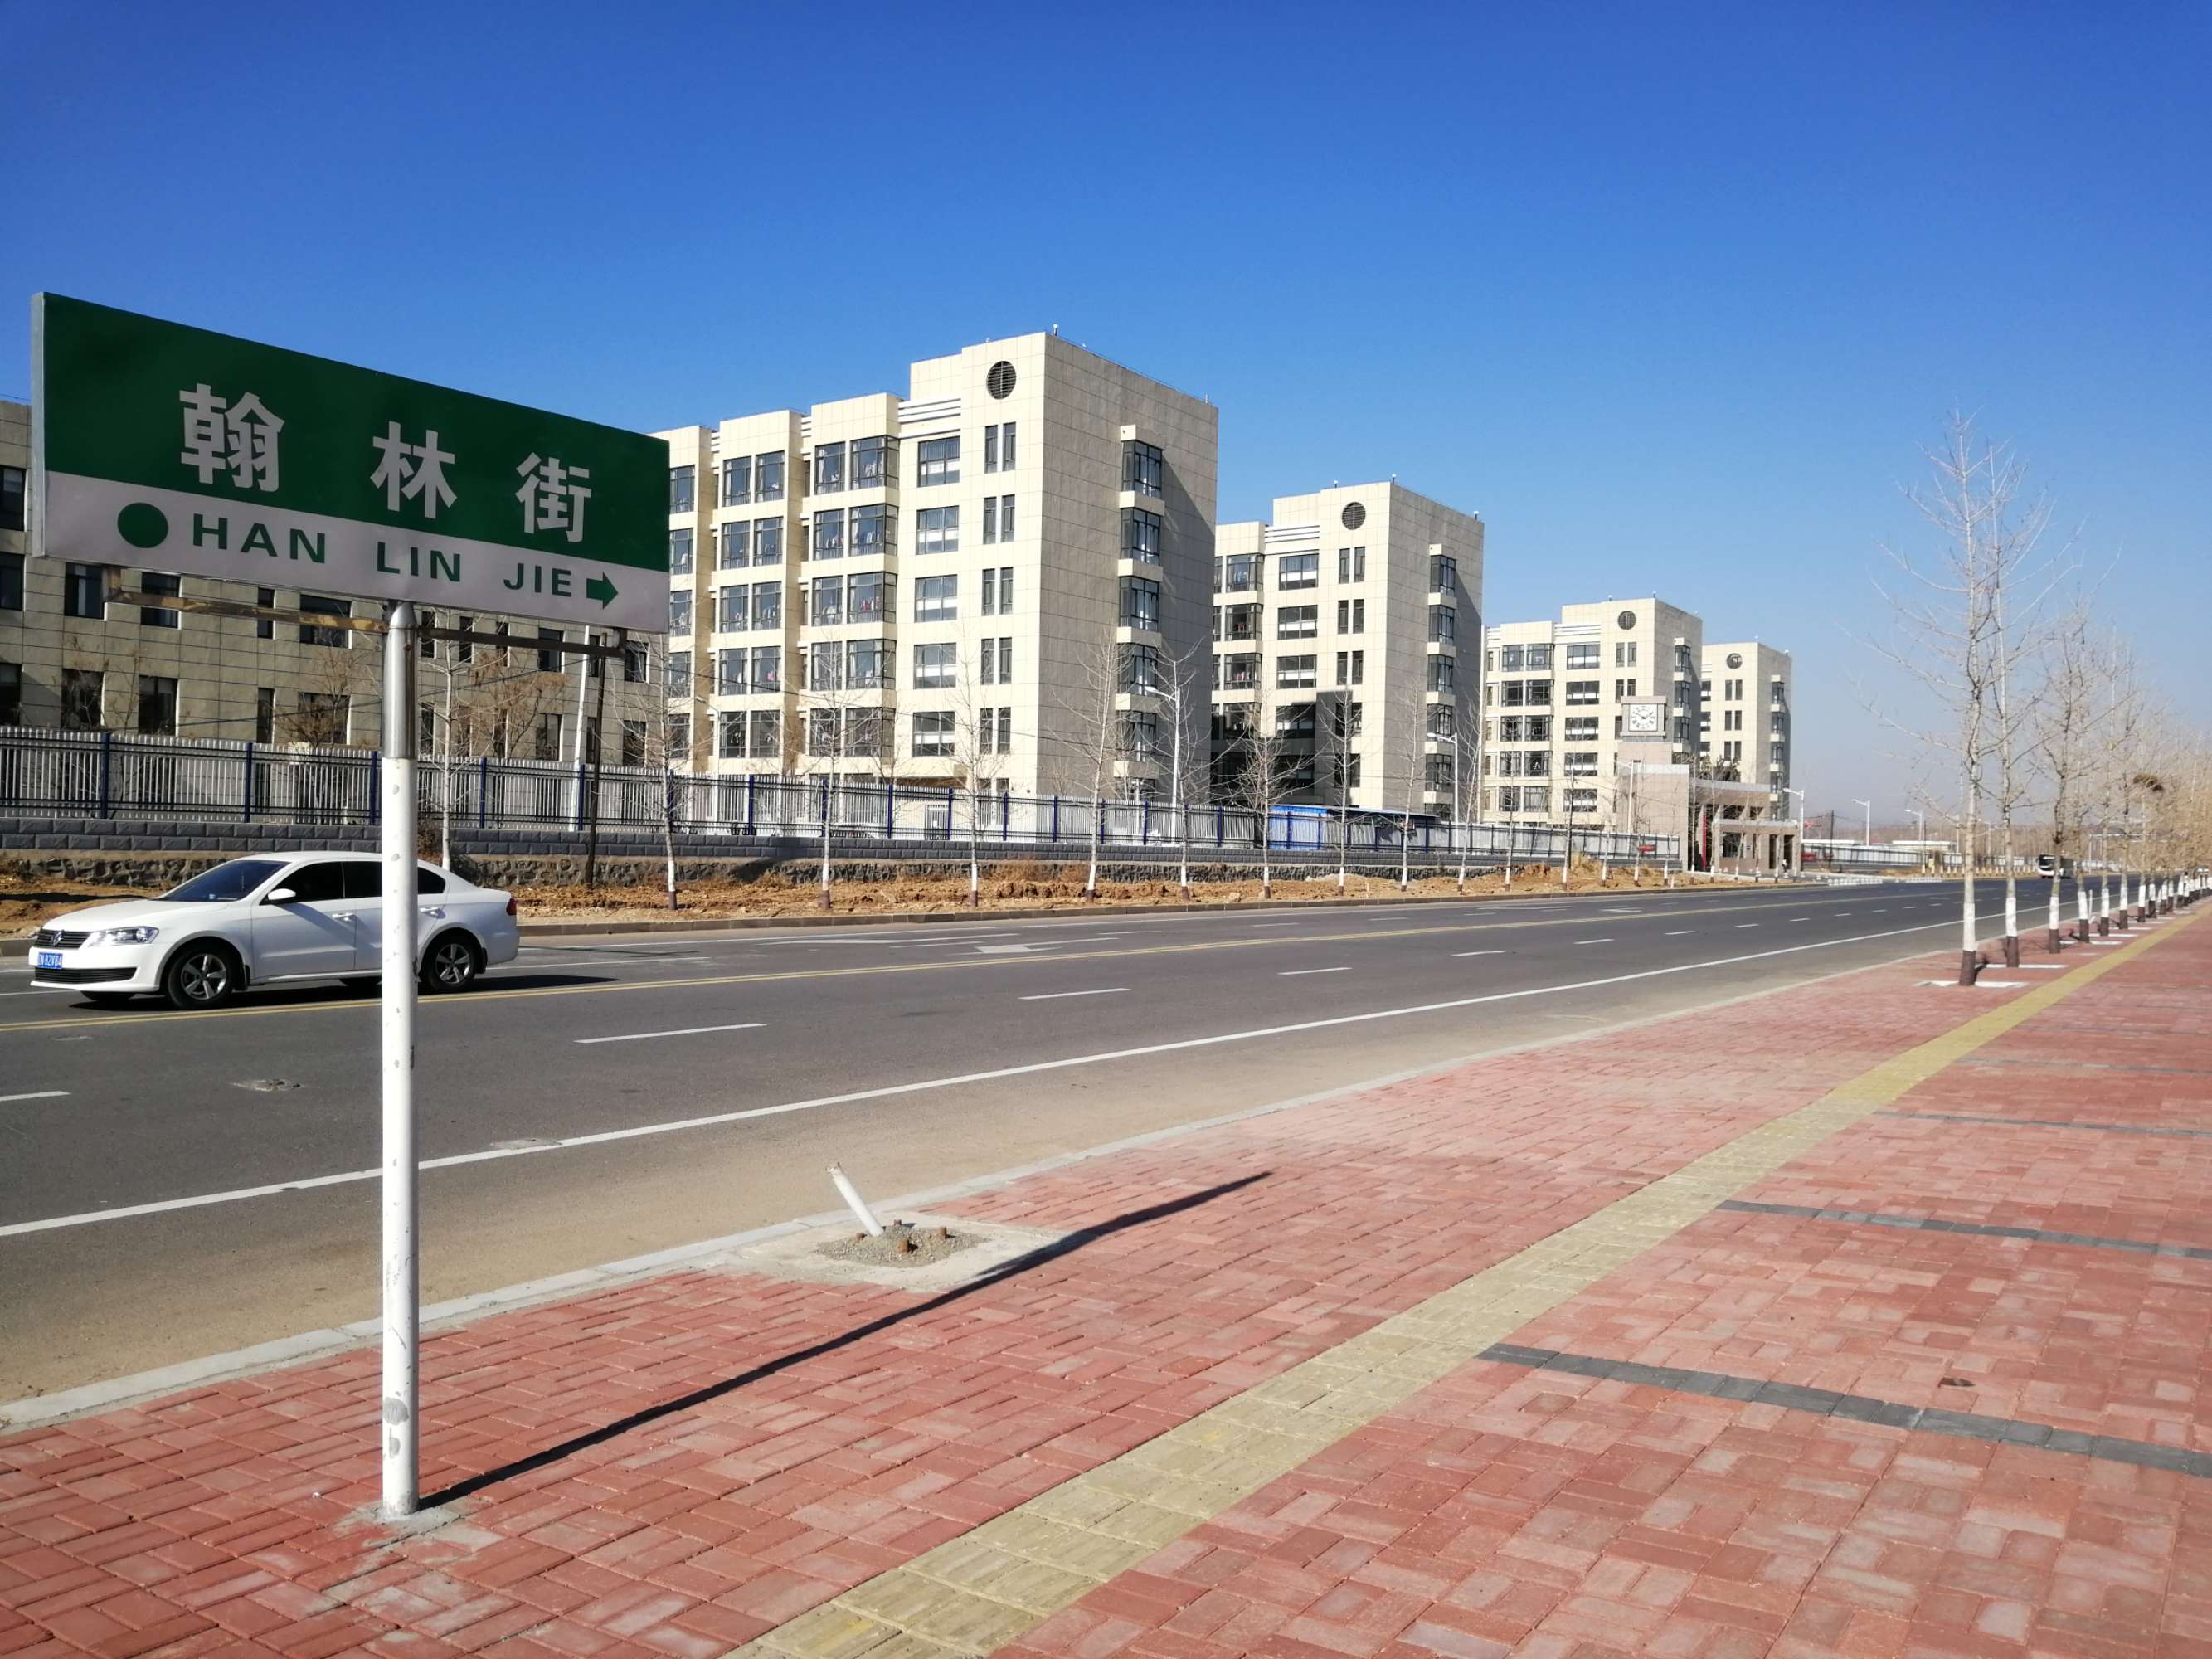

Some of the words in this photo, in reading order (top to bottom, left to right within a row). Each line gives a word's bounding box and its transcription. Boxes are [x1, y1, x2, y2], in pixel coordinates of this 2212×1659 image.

[180, 383, 591, 542] 翰林街
[192, 513, 326, 565] HAN
[376, 541, 461, 583] LIN
[503, 562, 573, 598] JIE
